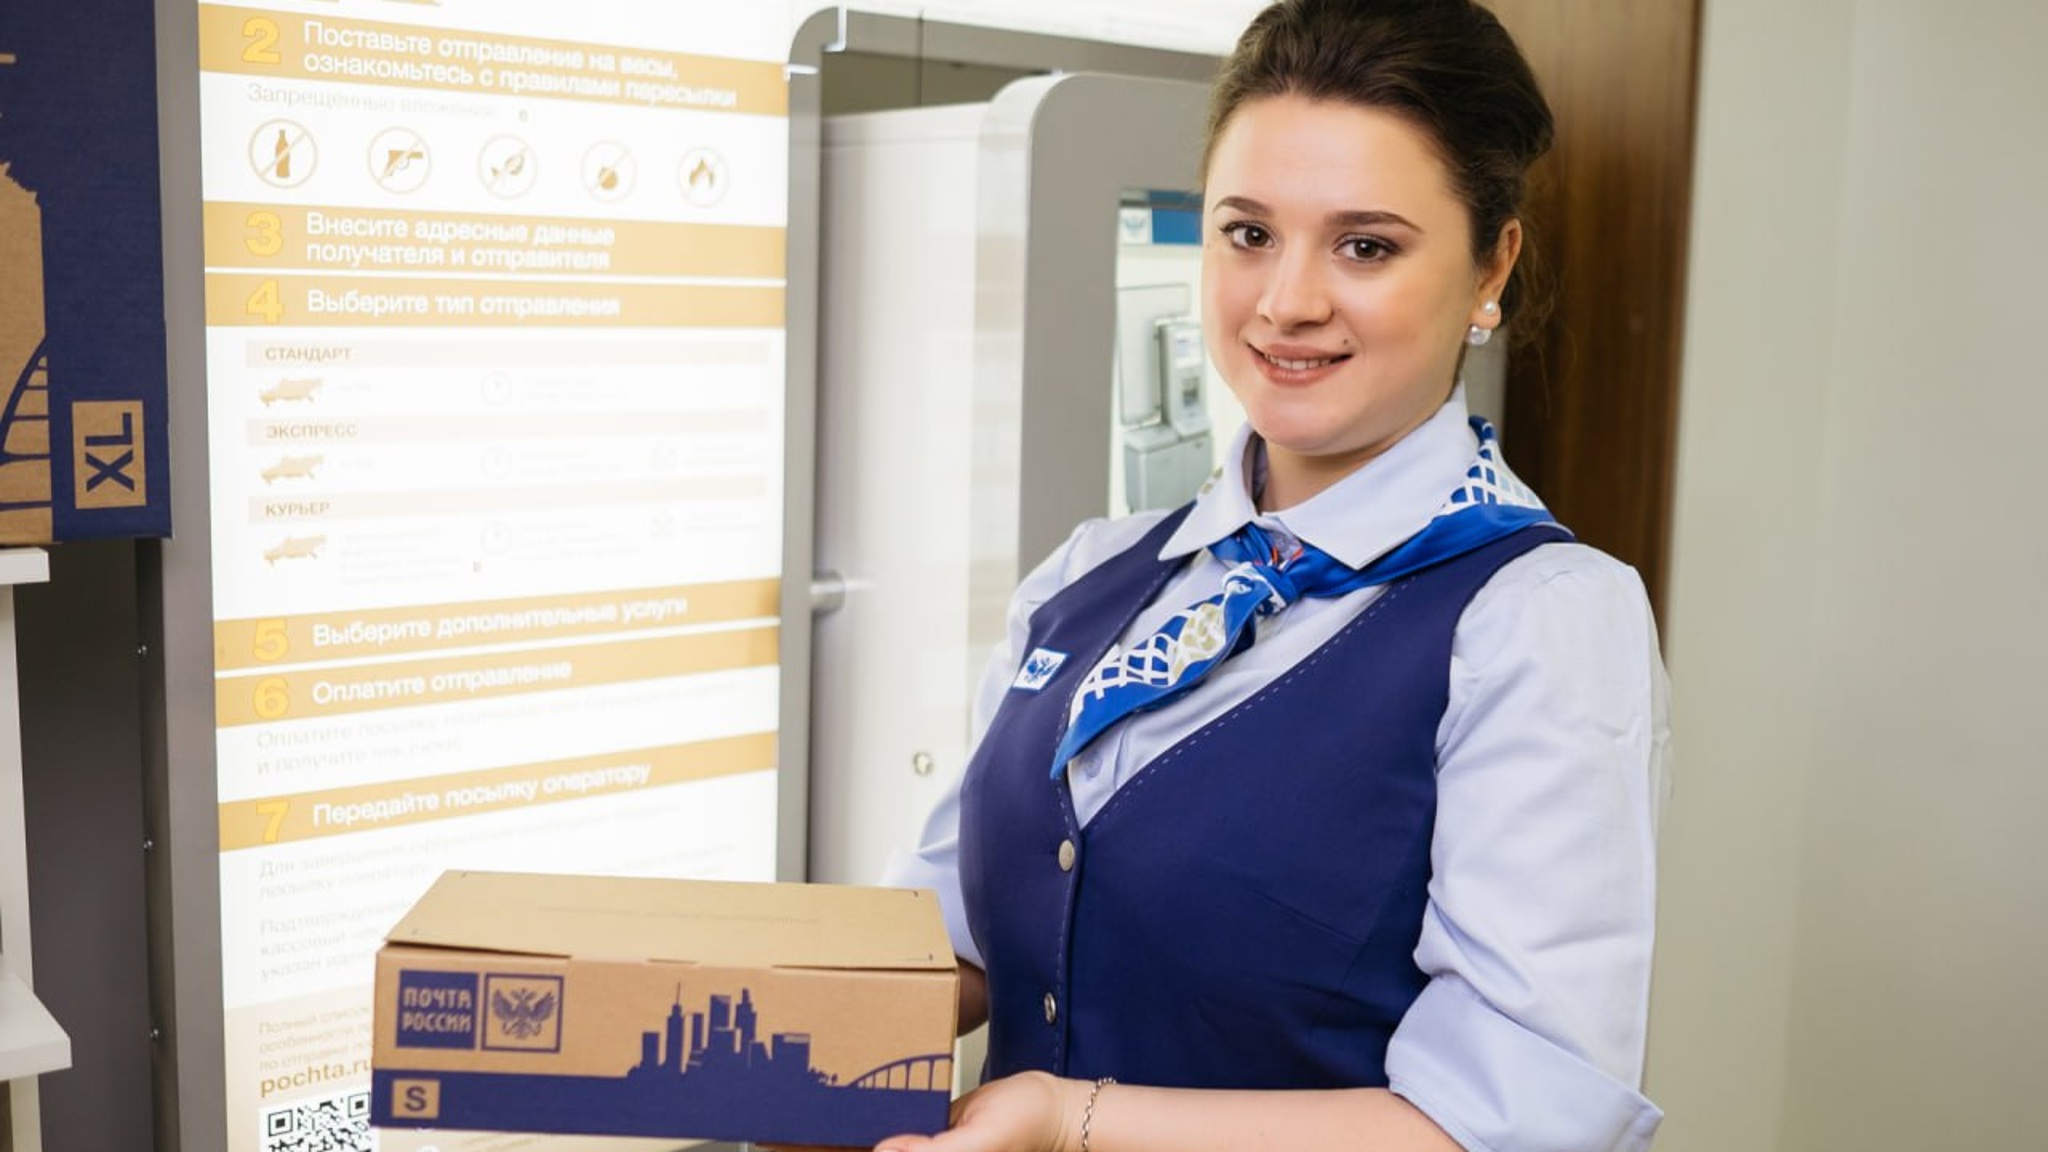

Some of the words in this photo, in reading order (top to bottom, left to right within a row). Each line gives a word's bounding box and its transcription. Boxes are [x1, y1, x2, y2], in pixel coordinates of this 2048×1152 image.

[241, 15, 282, 64] 2
[304, 21, 432, 54] Поставьте
[438, 37, 584, 70] отправление
[589, 54, 615, 72] на
[620, 56, 679, 81] весы,
[304, 53, 474, 85] ознакомьтесь
[479, 67, 494, 87] с
[499, 69, 620, 97] правилами
[244, 211, 284, 257] 3
[306, 211, 408, 236] Внесите
[415, 219, 528, 243] адресные
[533, 224, 615, 246] данные
[306, 243, 444, 268] получателя
[450, 247, 465, 265] и
[471, 247, 611, 270] отправителя
[245, 278, 284, 324] 4
[307, 288, 429, 318] Выберите
[434, 295, 474, 315] тип
[480, 295, 621, 321] отправления
[264, 346, 352, 362] СТАНДАРТ
[84, 412, 135, 493] XL
[265, 423, 358, 439] ЭКСПРЕСС
[265, 501, 331, 517] КУРЬЕР
[252, 618, 290, 663] 5
[313, 618, 432, 647] Выберите
[436, 603, 618, 640] дополнительные
[621, 597, 688, 624] услуги
[252, 675, 290, 720] 6
[313, 674, 425, 705] Оплатите
[431, 660, 573, 693] отправление
[313, 791, 440, 827] Передайте
[446, 778, 538, 808] посылку
[543, 763, 652, 793] оператору
[255, 799, 290, 844] 7
[403, 987, 472, 1009] ПОЧТА
[402, 1011, 472, 1033] РОССИИ
[260, 1059, 372, 1097] pochta.ru
[404, 1085, 427, 1112] S
